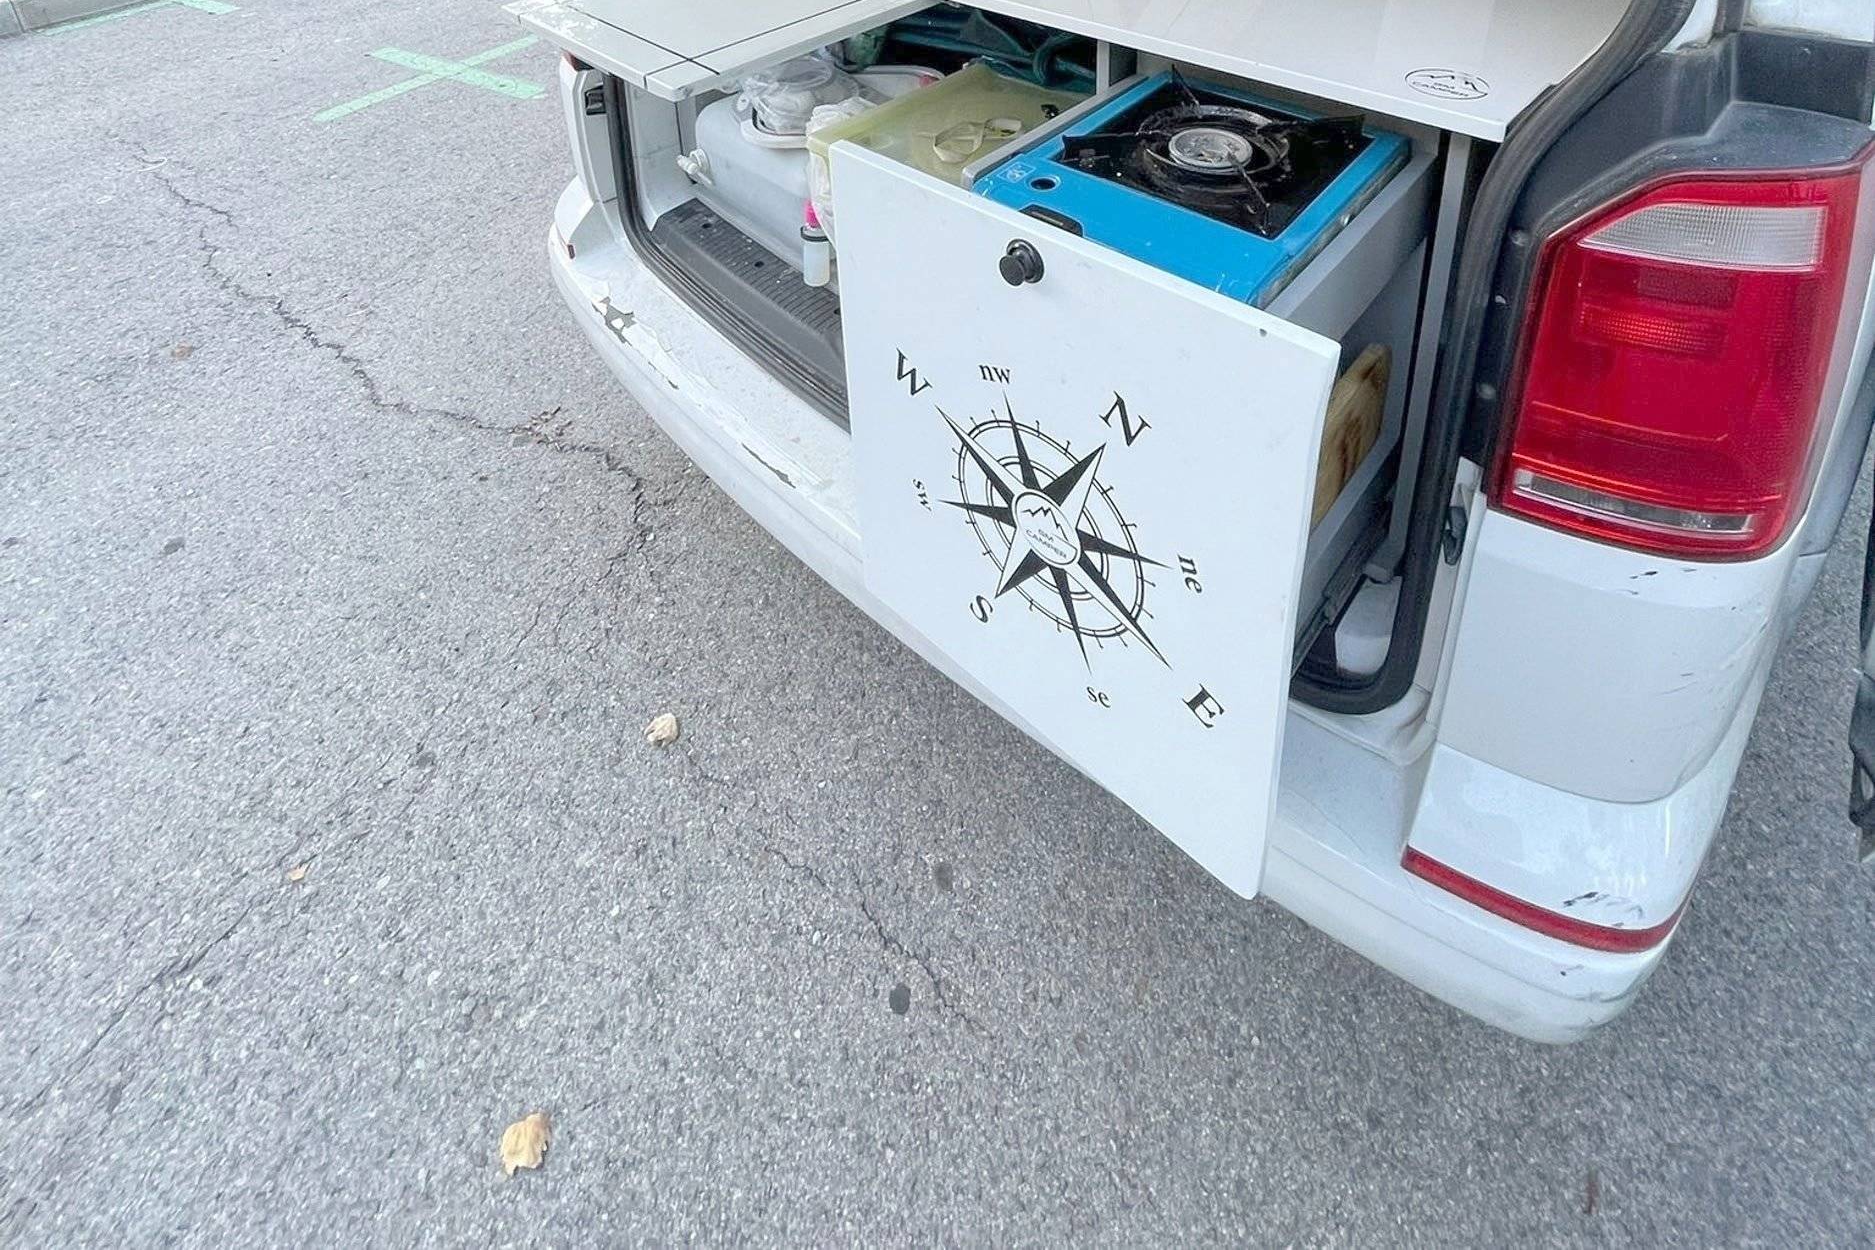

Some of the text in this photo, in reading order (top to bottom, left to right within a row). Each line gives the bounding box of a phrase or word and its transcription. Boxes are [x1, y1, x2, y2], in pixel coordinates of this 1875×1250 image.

[896, 347, 933, 397] W
[978, 363, 1011, 386] nw
[1098, 390, 1153, 448] N
[1177, 553, 1204, 594] ne
[969, 594, 995, 625] S
[1085, 685, 1112, 709] se
[1180, 682, 1226, 730] E
